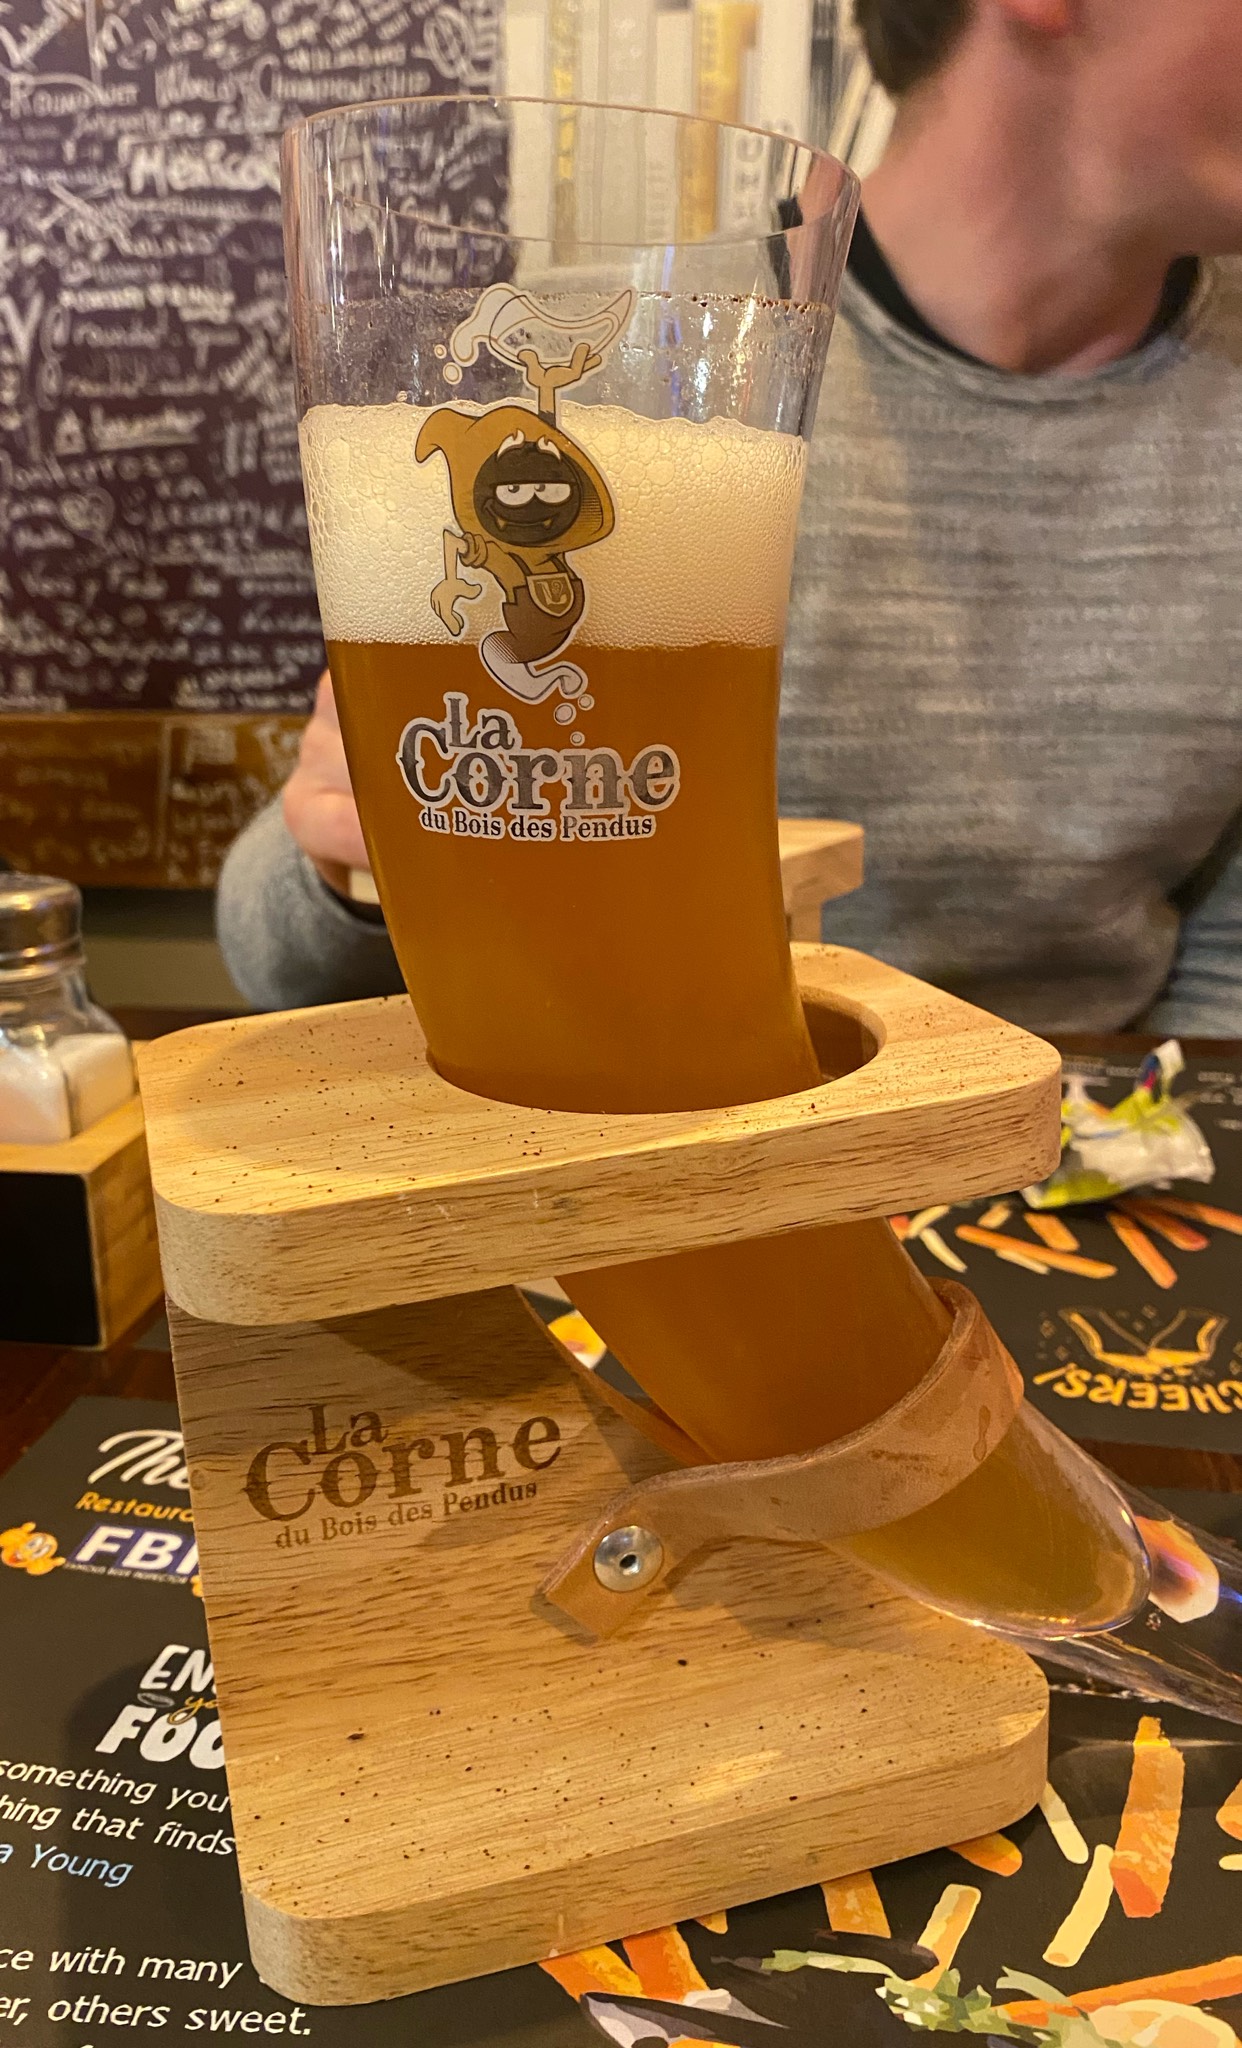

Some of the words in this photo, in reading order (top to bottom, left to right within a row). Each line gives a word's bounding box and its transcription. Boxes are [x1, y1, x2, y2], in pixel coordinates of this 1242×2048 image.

[444, 695, 517, 750] La
[399, 722, 676, 808] Corne
[420, 807, 448, 832] du
[454, 810, 503, 837] Bois
[509, 815, 553, 839] des
[561, 813, 653, 840] Pendus
[307, 1403, 389, 1456] La
[240, 1415, 563, 1522] Corne
[275, 1525, 310, 1549] du
[320, 1509, 378, 1541] Bois
[387, 1502, 433, 1527] des
[442, 1481, 538, 1517] Pendus
[0, 1760, 157, 1806] something
[166, 1787, 231, 1813] you
[72, 1807, 143, 1841] that
[154, 1821, 236, 1856] finds
[30, 1843, 133, 1888] Young
[49, 1946, 126, 1975] with
[137, 1957, 243, 1989] many
[48, 1994, 171, 2028] others
[184, 2006, 312, 2037] sweet.
